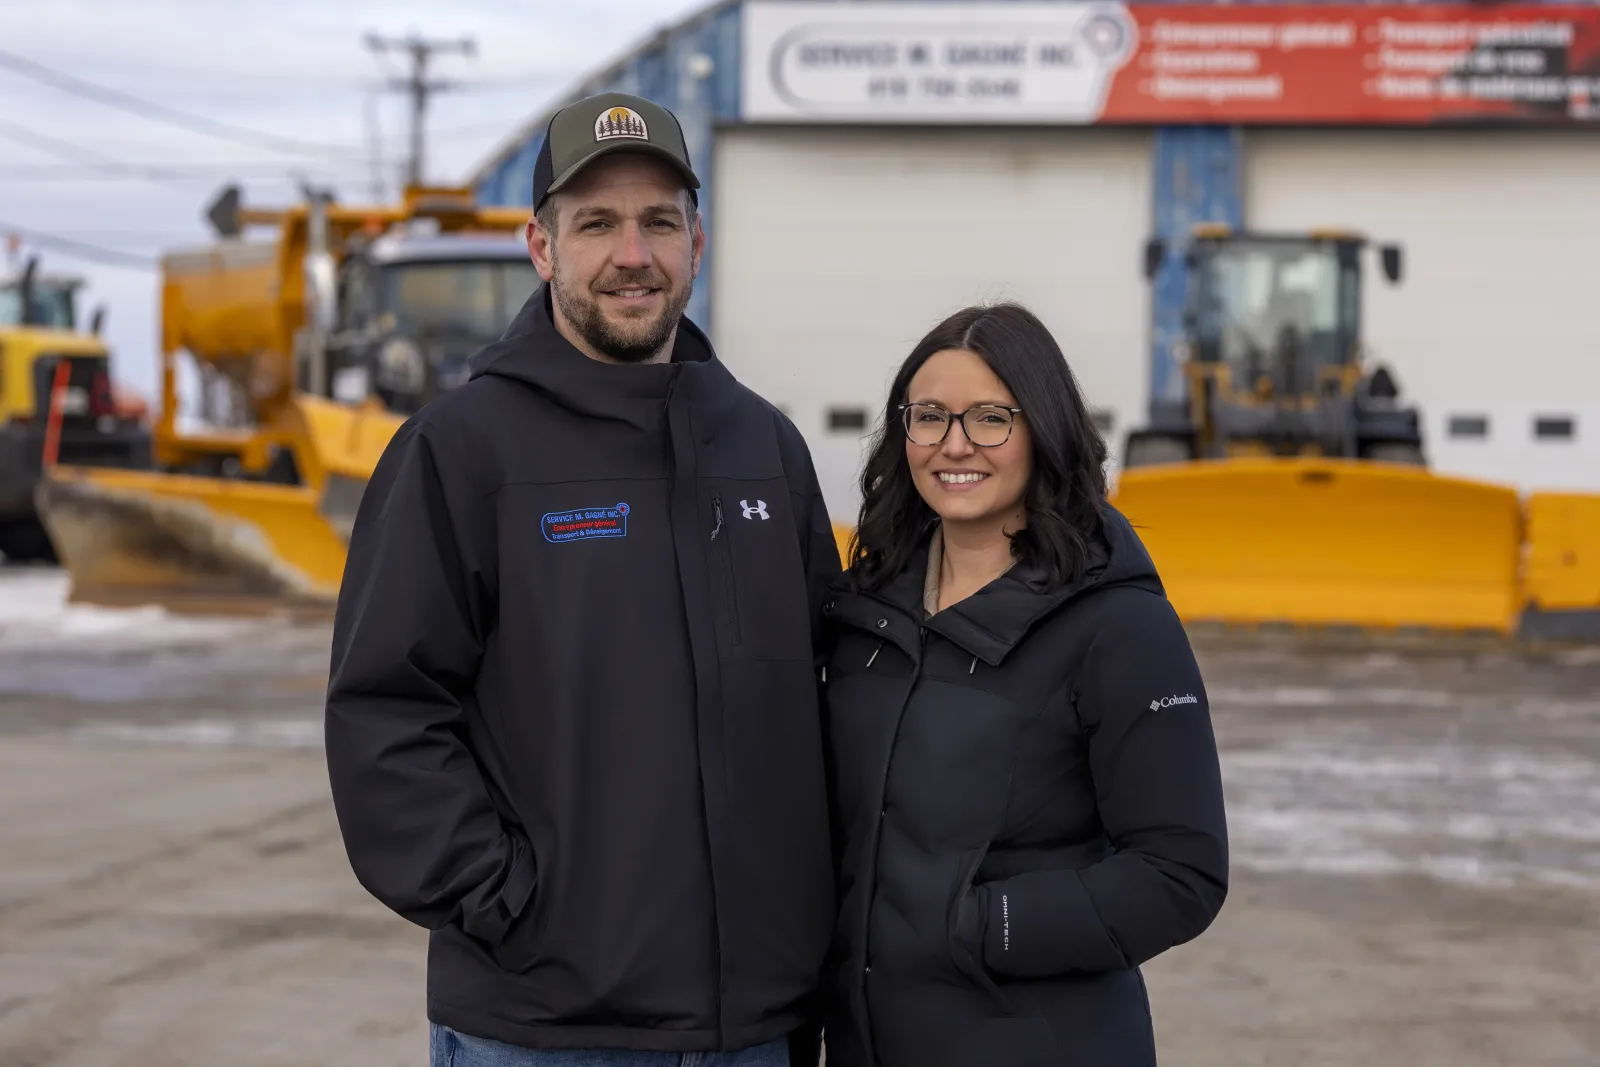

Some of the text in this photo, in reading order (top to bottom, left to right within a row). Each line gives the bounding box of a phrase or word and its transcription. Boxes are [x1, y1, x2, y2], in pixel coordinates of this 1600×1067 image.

[546, 514, 574, 524] SERVICE
[575, 513, 584, 521] M.
[585, 509, 606, 519] GAGNÉ
[553, 519, 617, 532] Entrepreneur général
[551, 531, 579, 540] Transport
[1160, 694, 1198, 708] Columbia
